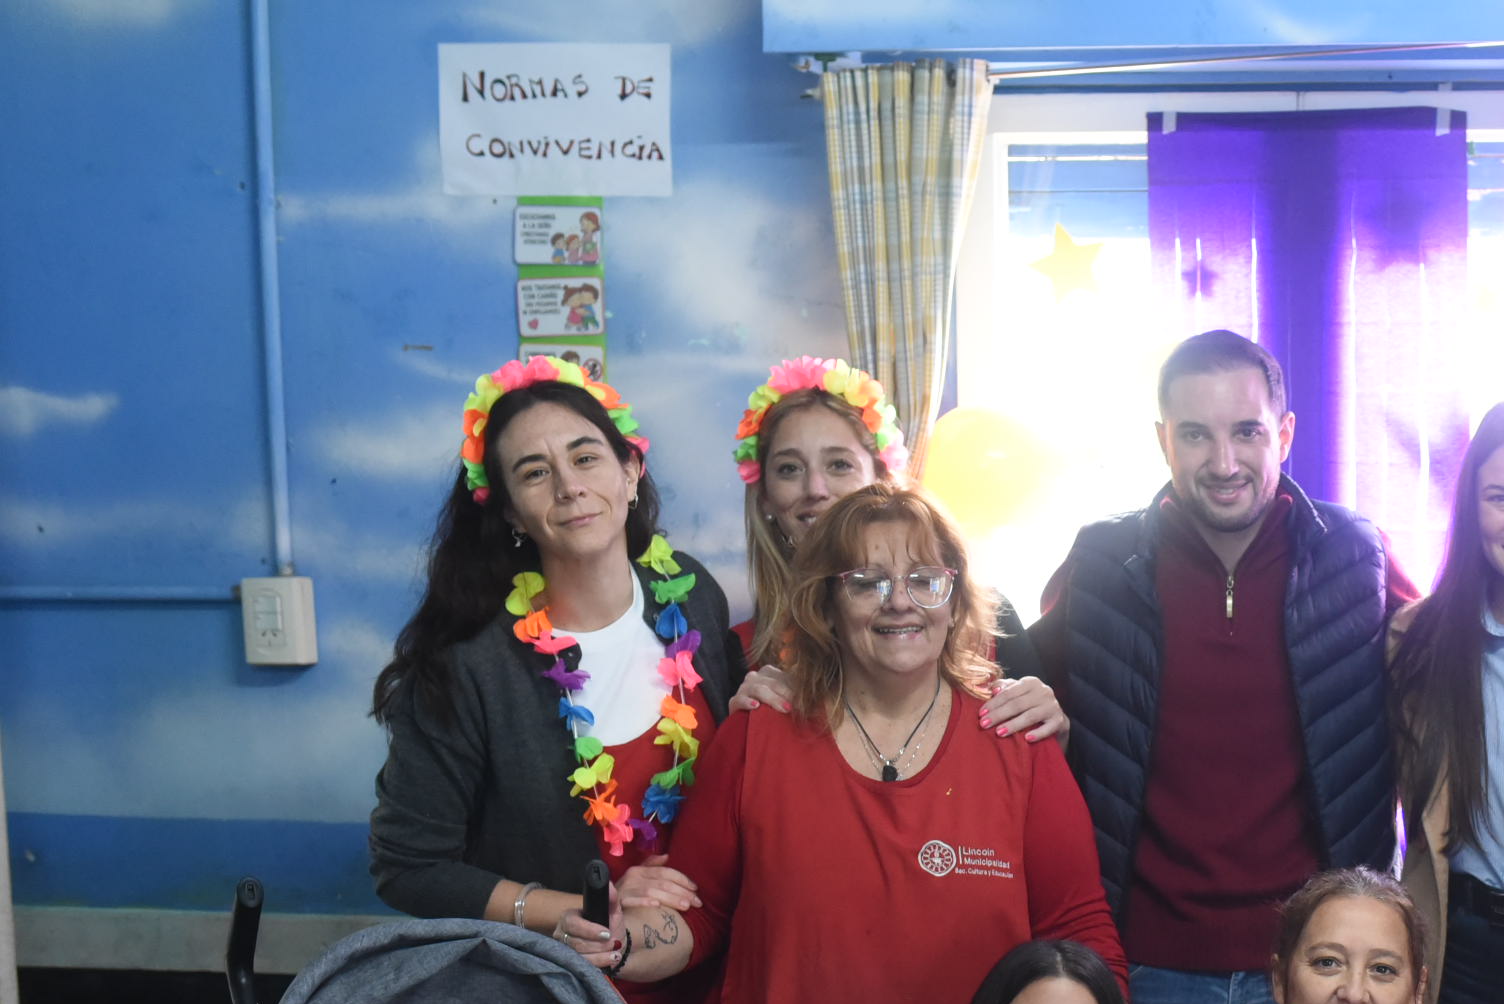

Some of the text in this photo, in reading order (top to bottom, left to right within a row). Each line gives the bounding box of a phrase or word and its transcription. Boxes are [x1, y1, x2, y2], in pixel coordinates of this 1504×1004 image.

[462, 70, 655, 102] NORMAS DE
[465, 133, 665, 161] CONVIVENCIA
